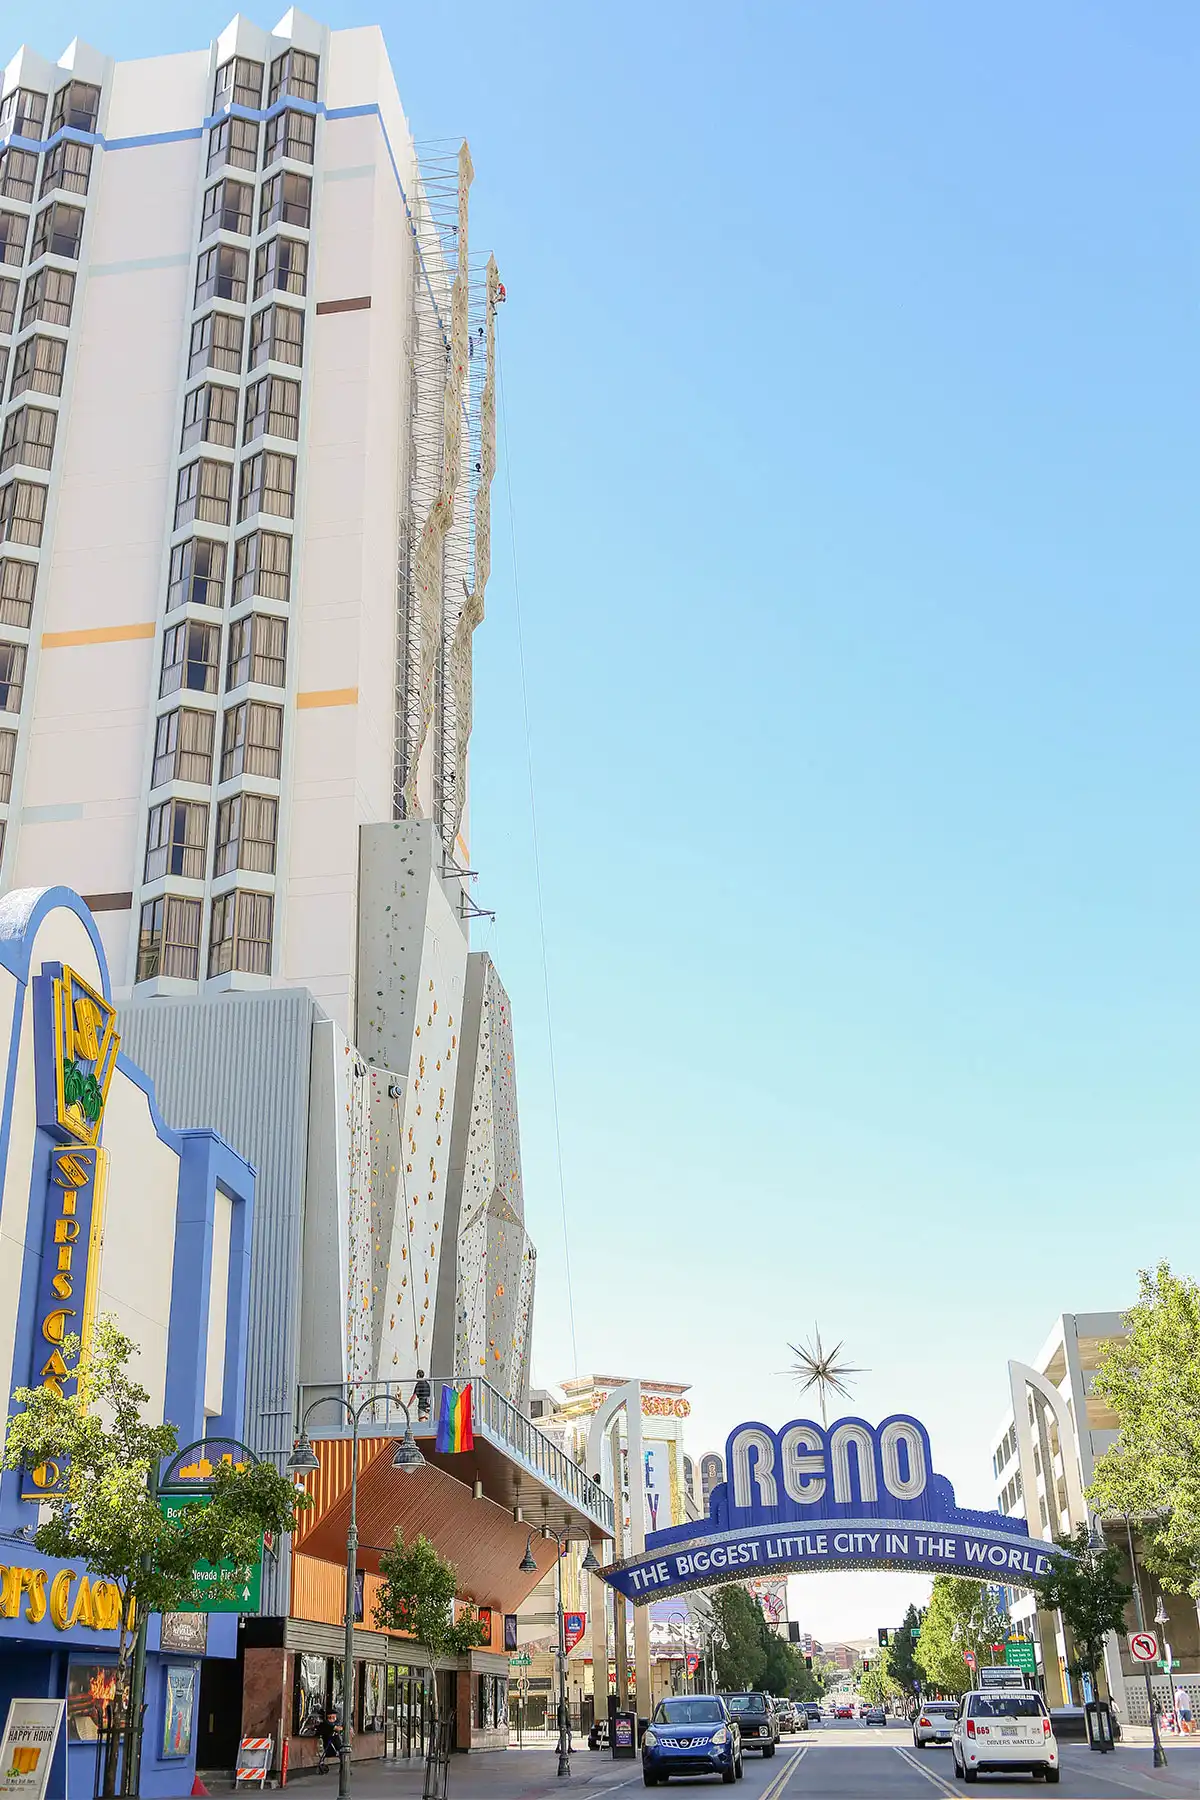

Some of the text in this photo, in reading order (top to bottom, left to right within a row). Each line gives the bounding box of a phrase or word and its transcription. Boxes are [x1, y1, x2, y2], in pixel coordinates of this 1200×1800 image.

[32, 1308, 77, 1488] CASO
[732, 1421, 928, 1508] RENO
[629, 1533, 1052, 1590] THE BIGGEST LITTLE CITY IN THE WORLD
[8, 1730, 53, 1741] HAPPY HOUR
